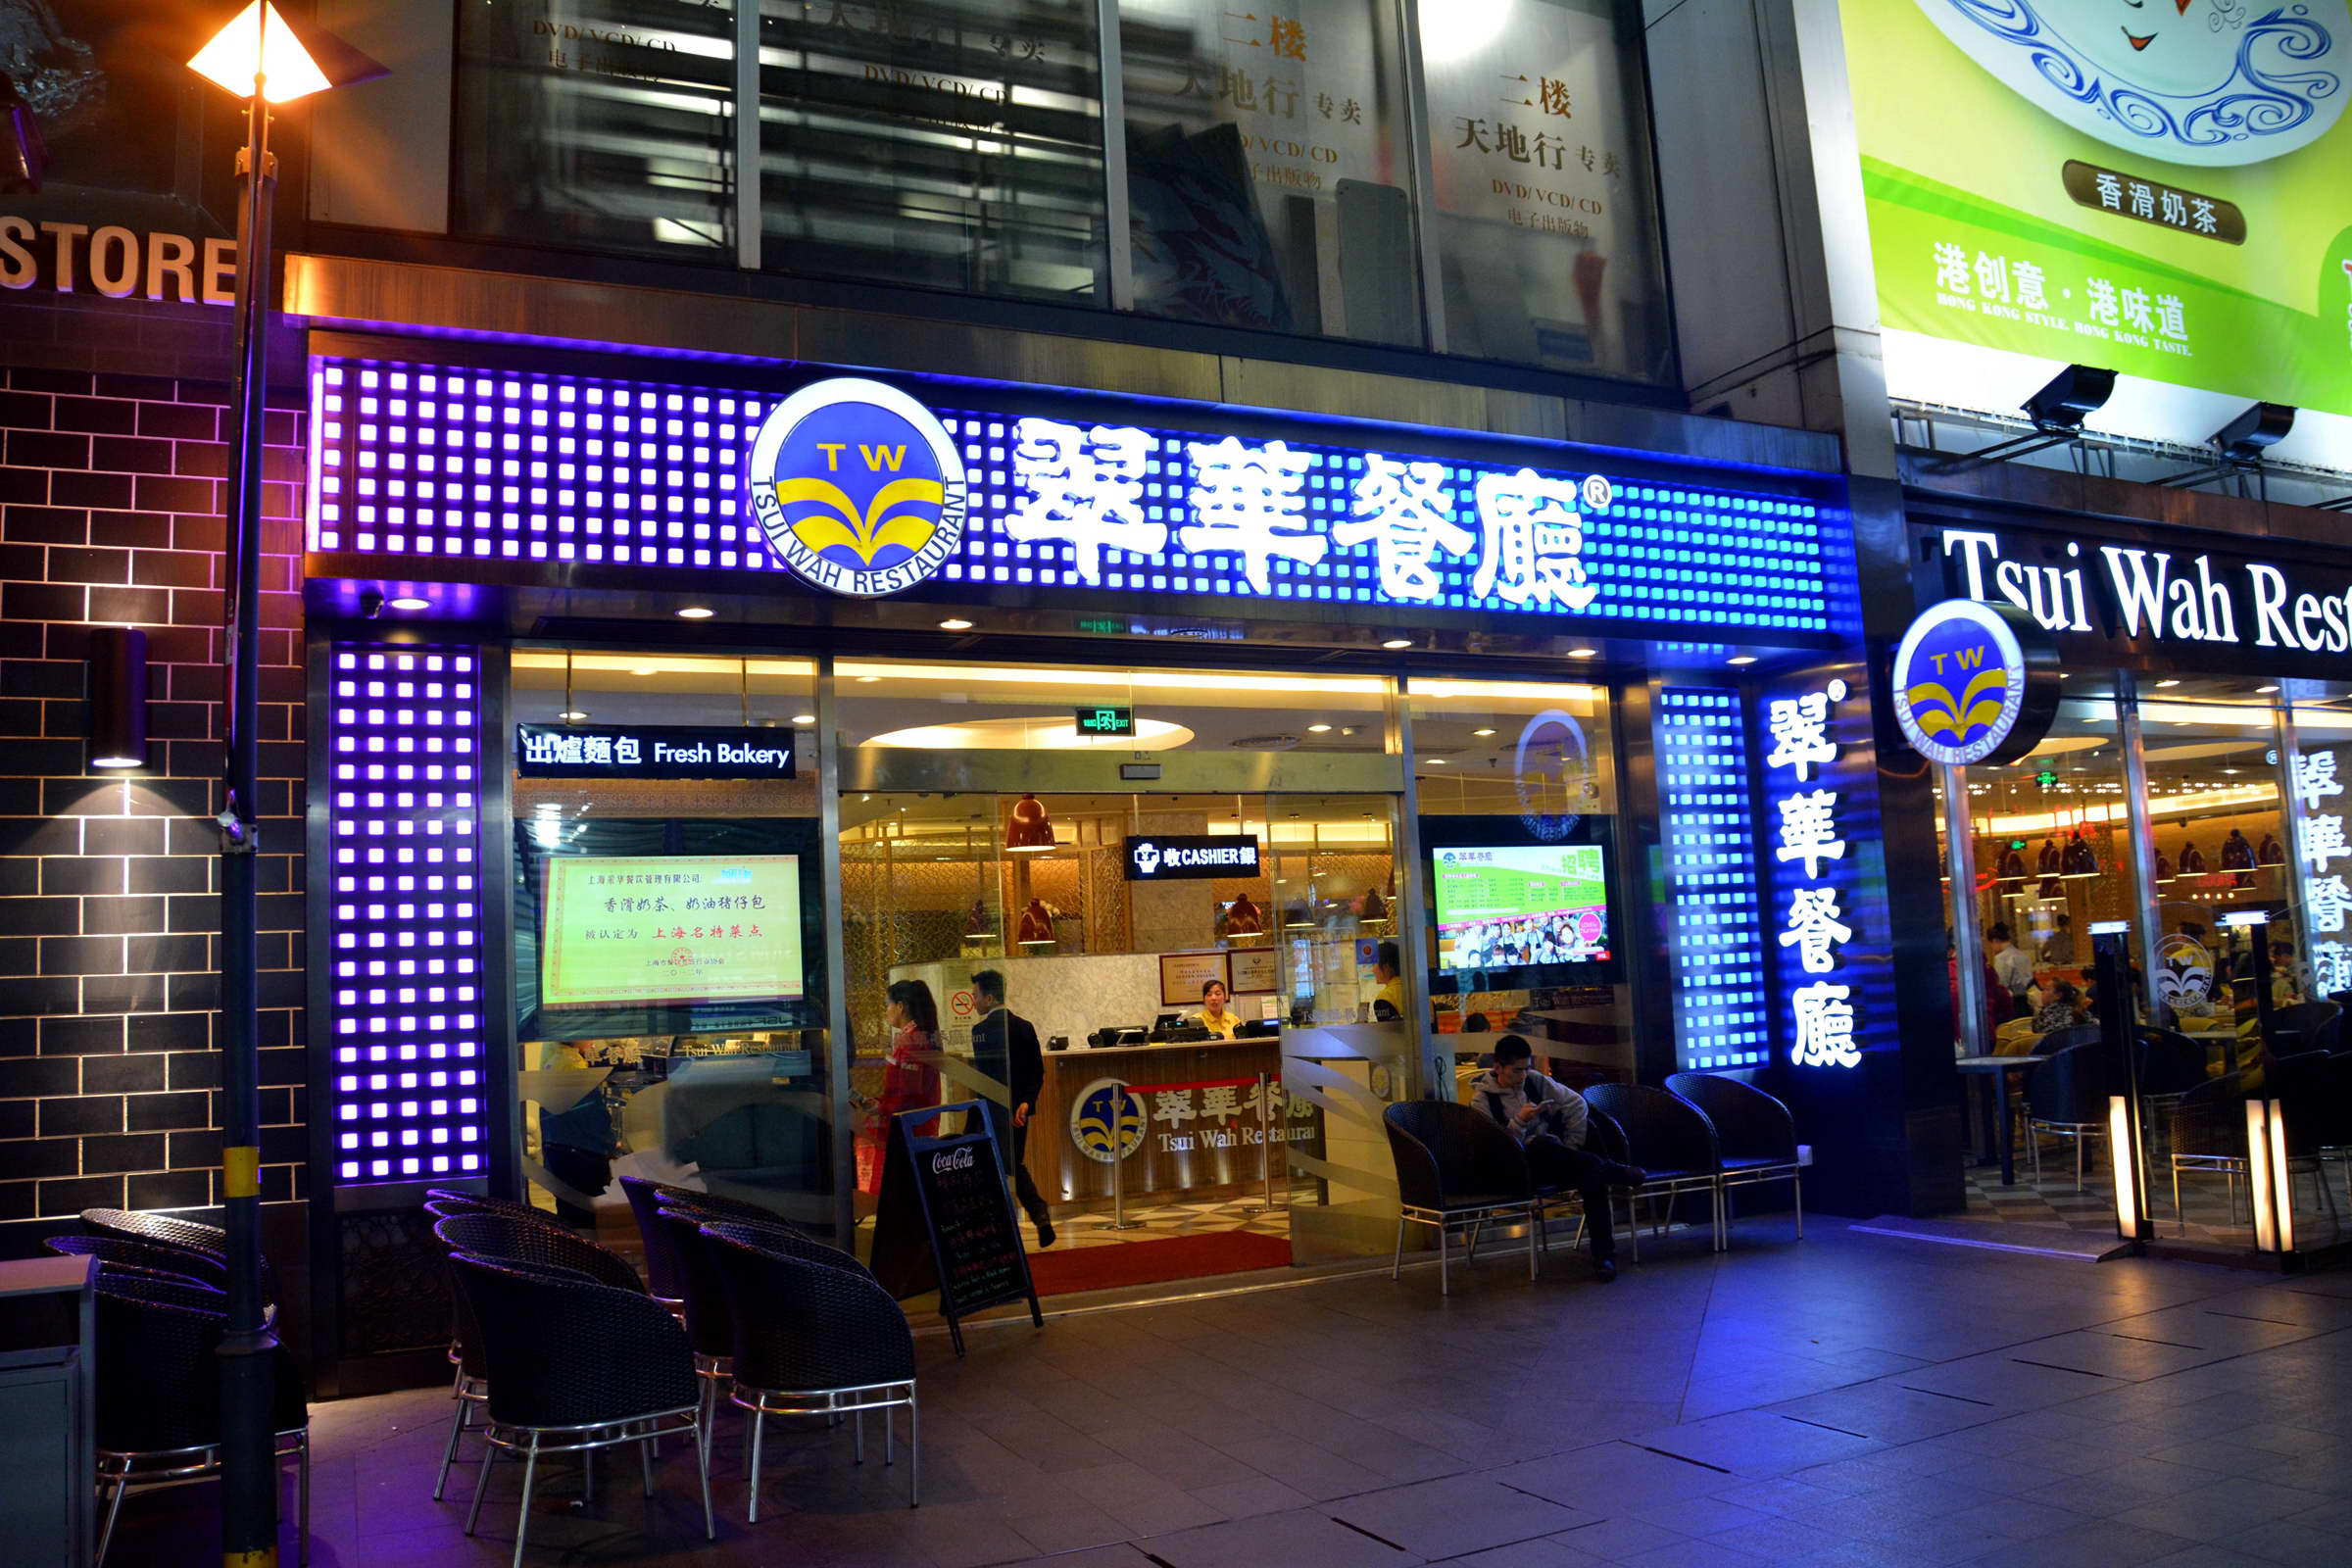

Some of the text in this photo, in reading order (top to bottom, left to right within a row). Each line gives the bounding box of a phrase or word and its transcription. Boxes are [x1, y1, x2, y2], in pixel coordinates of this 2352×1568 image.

[1222, 12, 1308, 62] 二楼
[1499, 74, 1572, 119] 二楼
[1257, 136, 1306, 158] VCD/
[1310, 145, 1338, 164] CD
[1455, 116, 1621, 178] 天地行 专卖
[1492, 179, 1602, 215] DVD/ VCD/ CD
[2095, 172, 2218, 234] 香滑奶茶
[0, 216, 237, 307] STORE
[1936, 293, 1977, 312] HONG
[1982, 302, 2020, 321] KONG
[2074, 320, 2109, 339] HONG
[2114, 330, 2149, 348] KONG
[753, 475, 965, 594] TSUI WAH RESTAURANT
[1003, 416, 1597, 611] 翠華餐廳
[1941, 529, 2093, 633] Tsui
[2099, 546, 2240, 643] Wah
[1115, 718, 1129, 728] EXIT
[1912, 730, 1946, 761] WAH
[654, 742, 711, 763] Fresh
[717, 743, 790, 768] Bakery
[1181, 848, 1240, 865] CASHIER
[1767, 691, 1862, 1068] 翠華餐廳
[1157, 1132, 1195, 1153] Tsui
[1199, 1128, 1237, 1150] Wah
